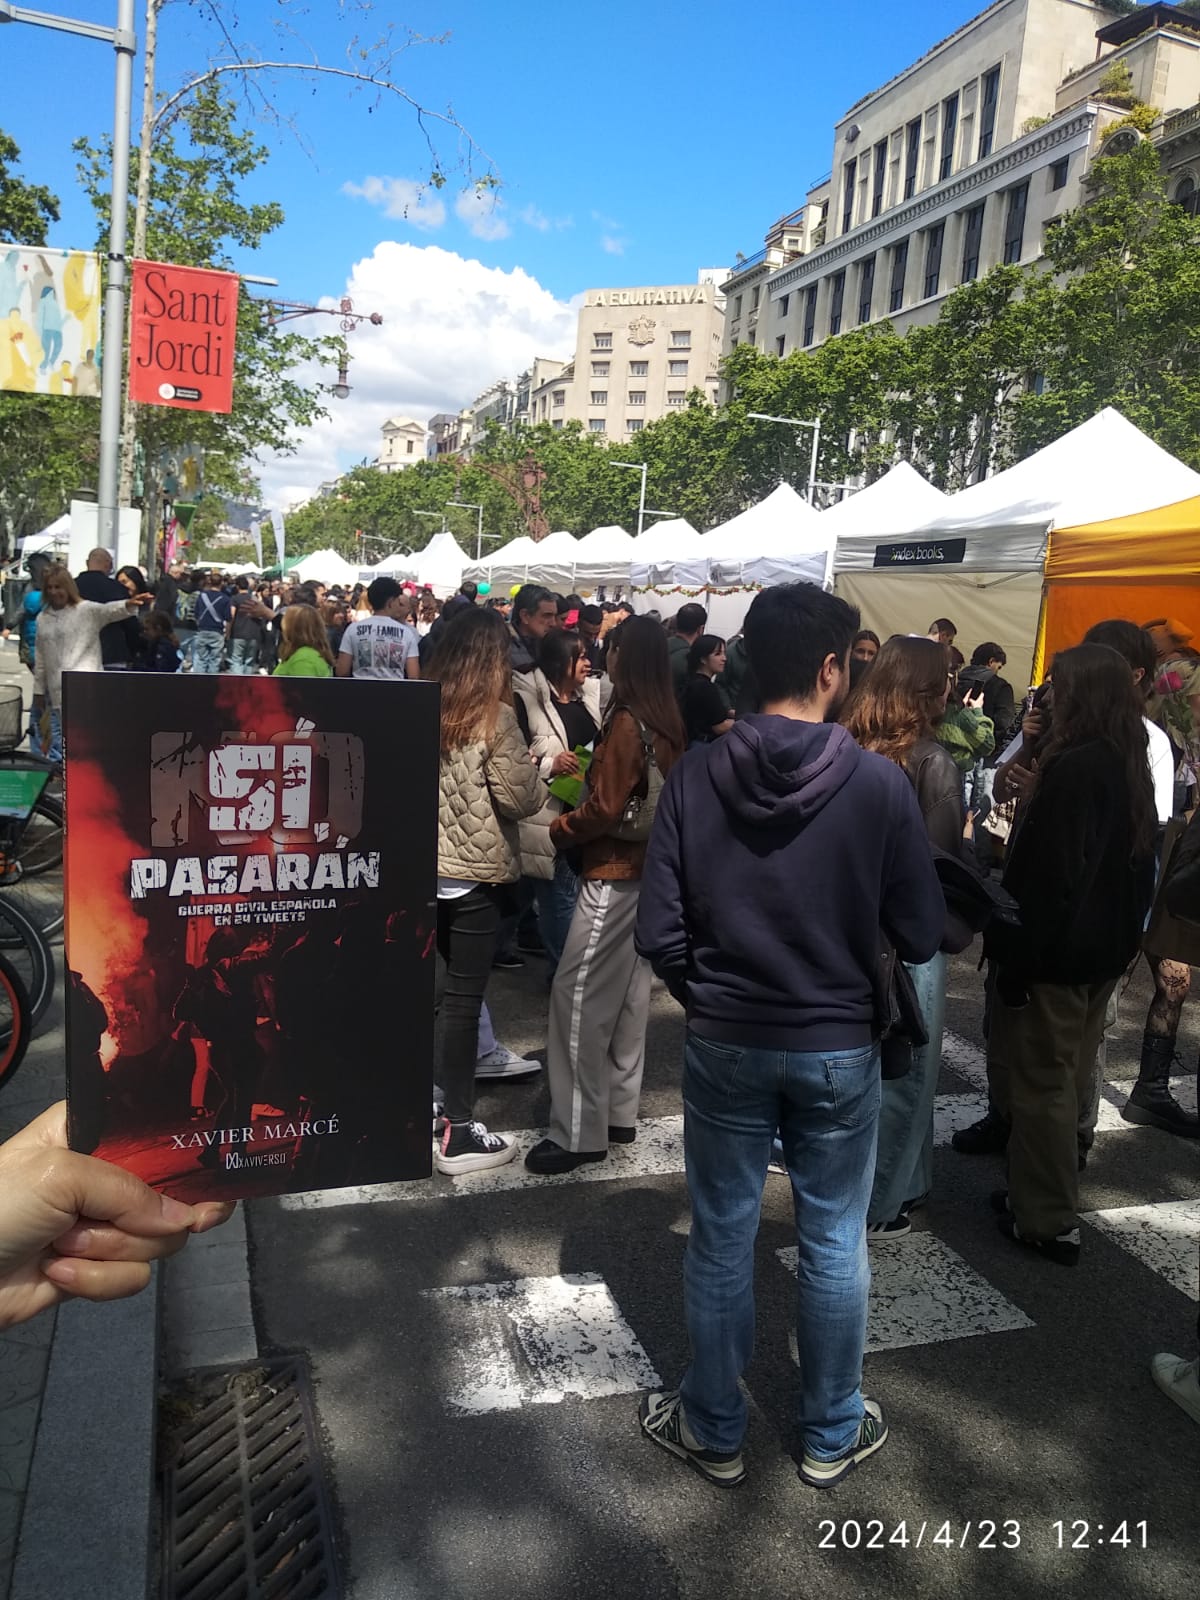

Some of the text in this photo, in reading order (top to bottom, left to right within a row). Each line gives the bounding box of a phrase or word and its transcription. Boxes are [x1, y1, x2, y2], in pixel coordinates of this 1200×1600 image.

[143, 271, 227, 327] Sant
[584, 287, 709, 307] LA EQUITATIVA
[136, 322, 224, 378] Jordi
[890, 546, 916, 561] index
[356, 623, 405, 638] SPY FAMILY
[130, 834, 381, 899] PASARÁN
[178, 903, 233, 917] GUERRA
[271, 897, 337, 911] ESPAÑOLA
[214, 911, 306, 926] EN 24 TWEETS
[171, 1114, 340, 1150] XAVIER MARCÉ
